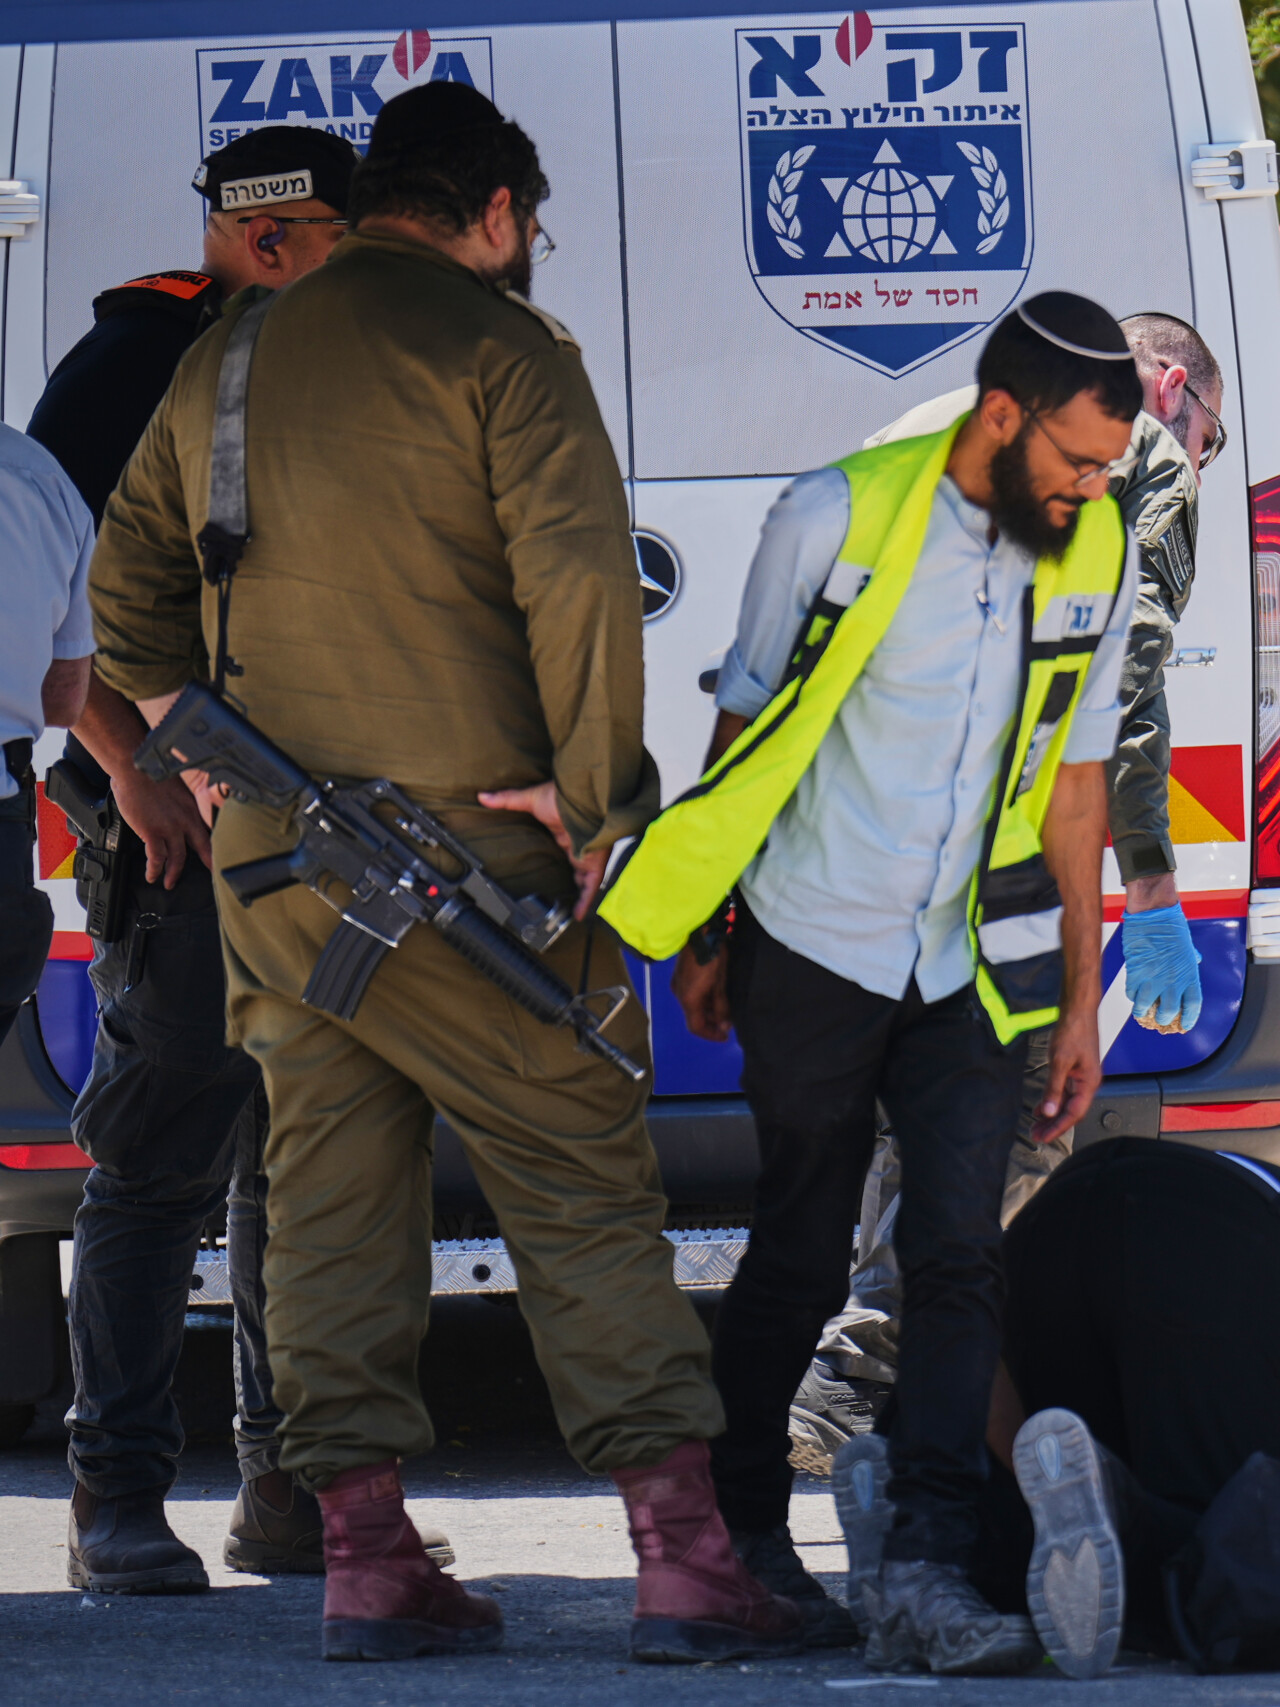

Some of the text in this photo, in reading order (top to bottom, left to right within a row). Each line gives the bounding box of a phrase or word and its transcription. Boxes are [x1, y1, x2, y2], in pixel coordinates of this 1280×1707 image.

[747, 103, 1021, 128] איתור חילוץ הצלה
[224, 176, 308, 204] משטרה
[802, 279, 978, 310] חסד של אמת
